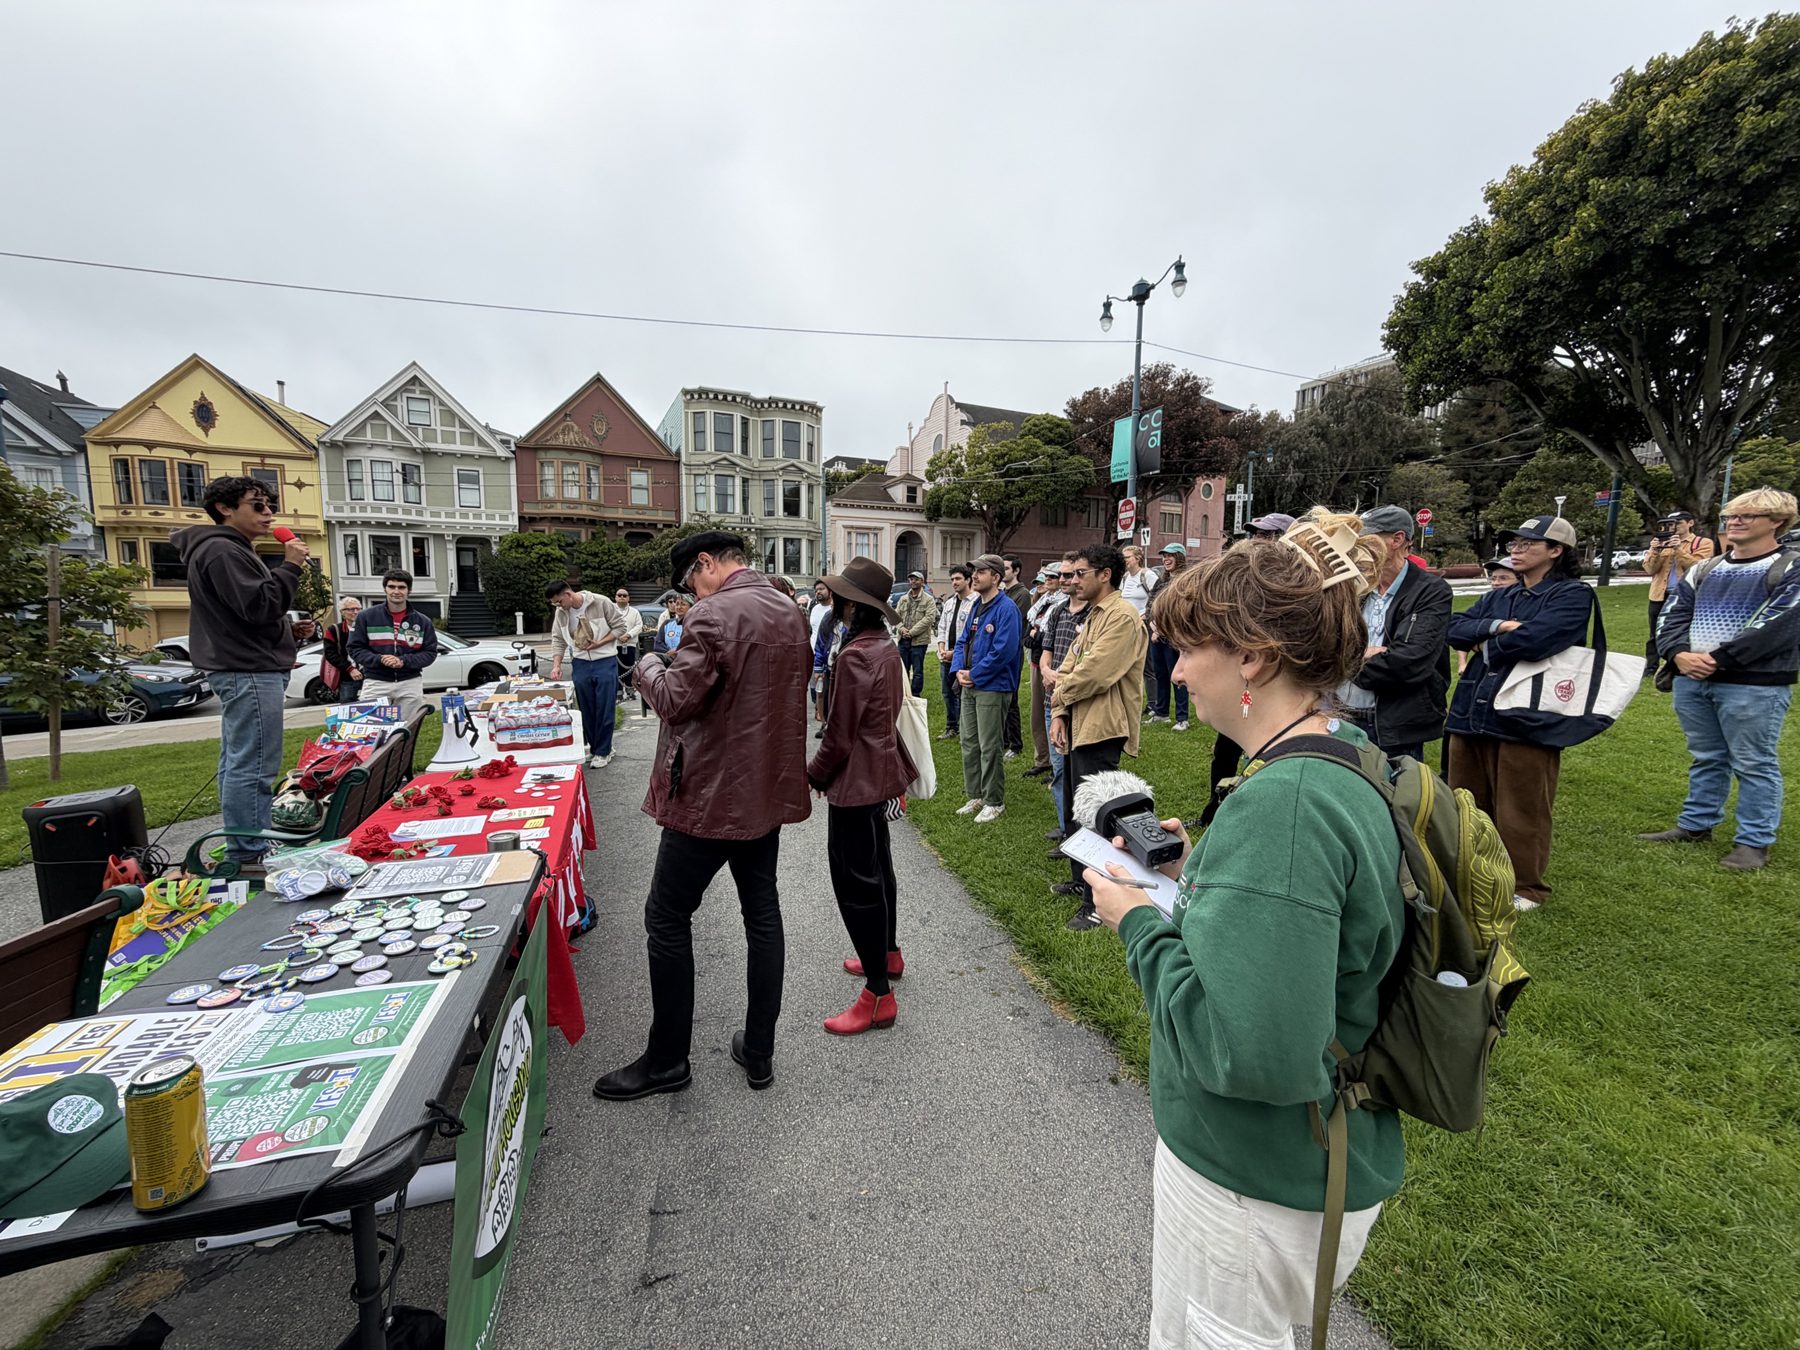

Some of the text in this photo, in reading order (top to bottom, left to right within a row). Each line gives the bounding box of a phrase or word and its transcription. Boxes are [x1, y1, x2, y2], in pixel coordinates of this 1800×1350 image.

[1235, 484, 1243, 530] CHRISTIAN
[371, 1004, 401, 1026] YES
[66, 1023, 114, 1049] YES
[309, 1085, 349, 1114] YES
